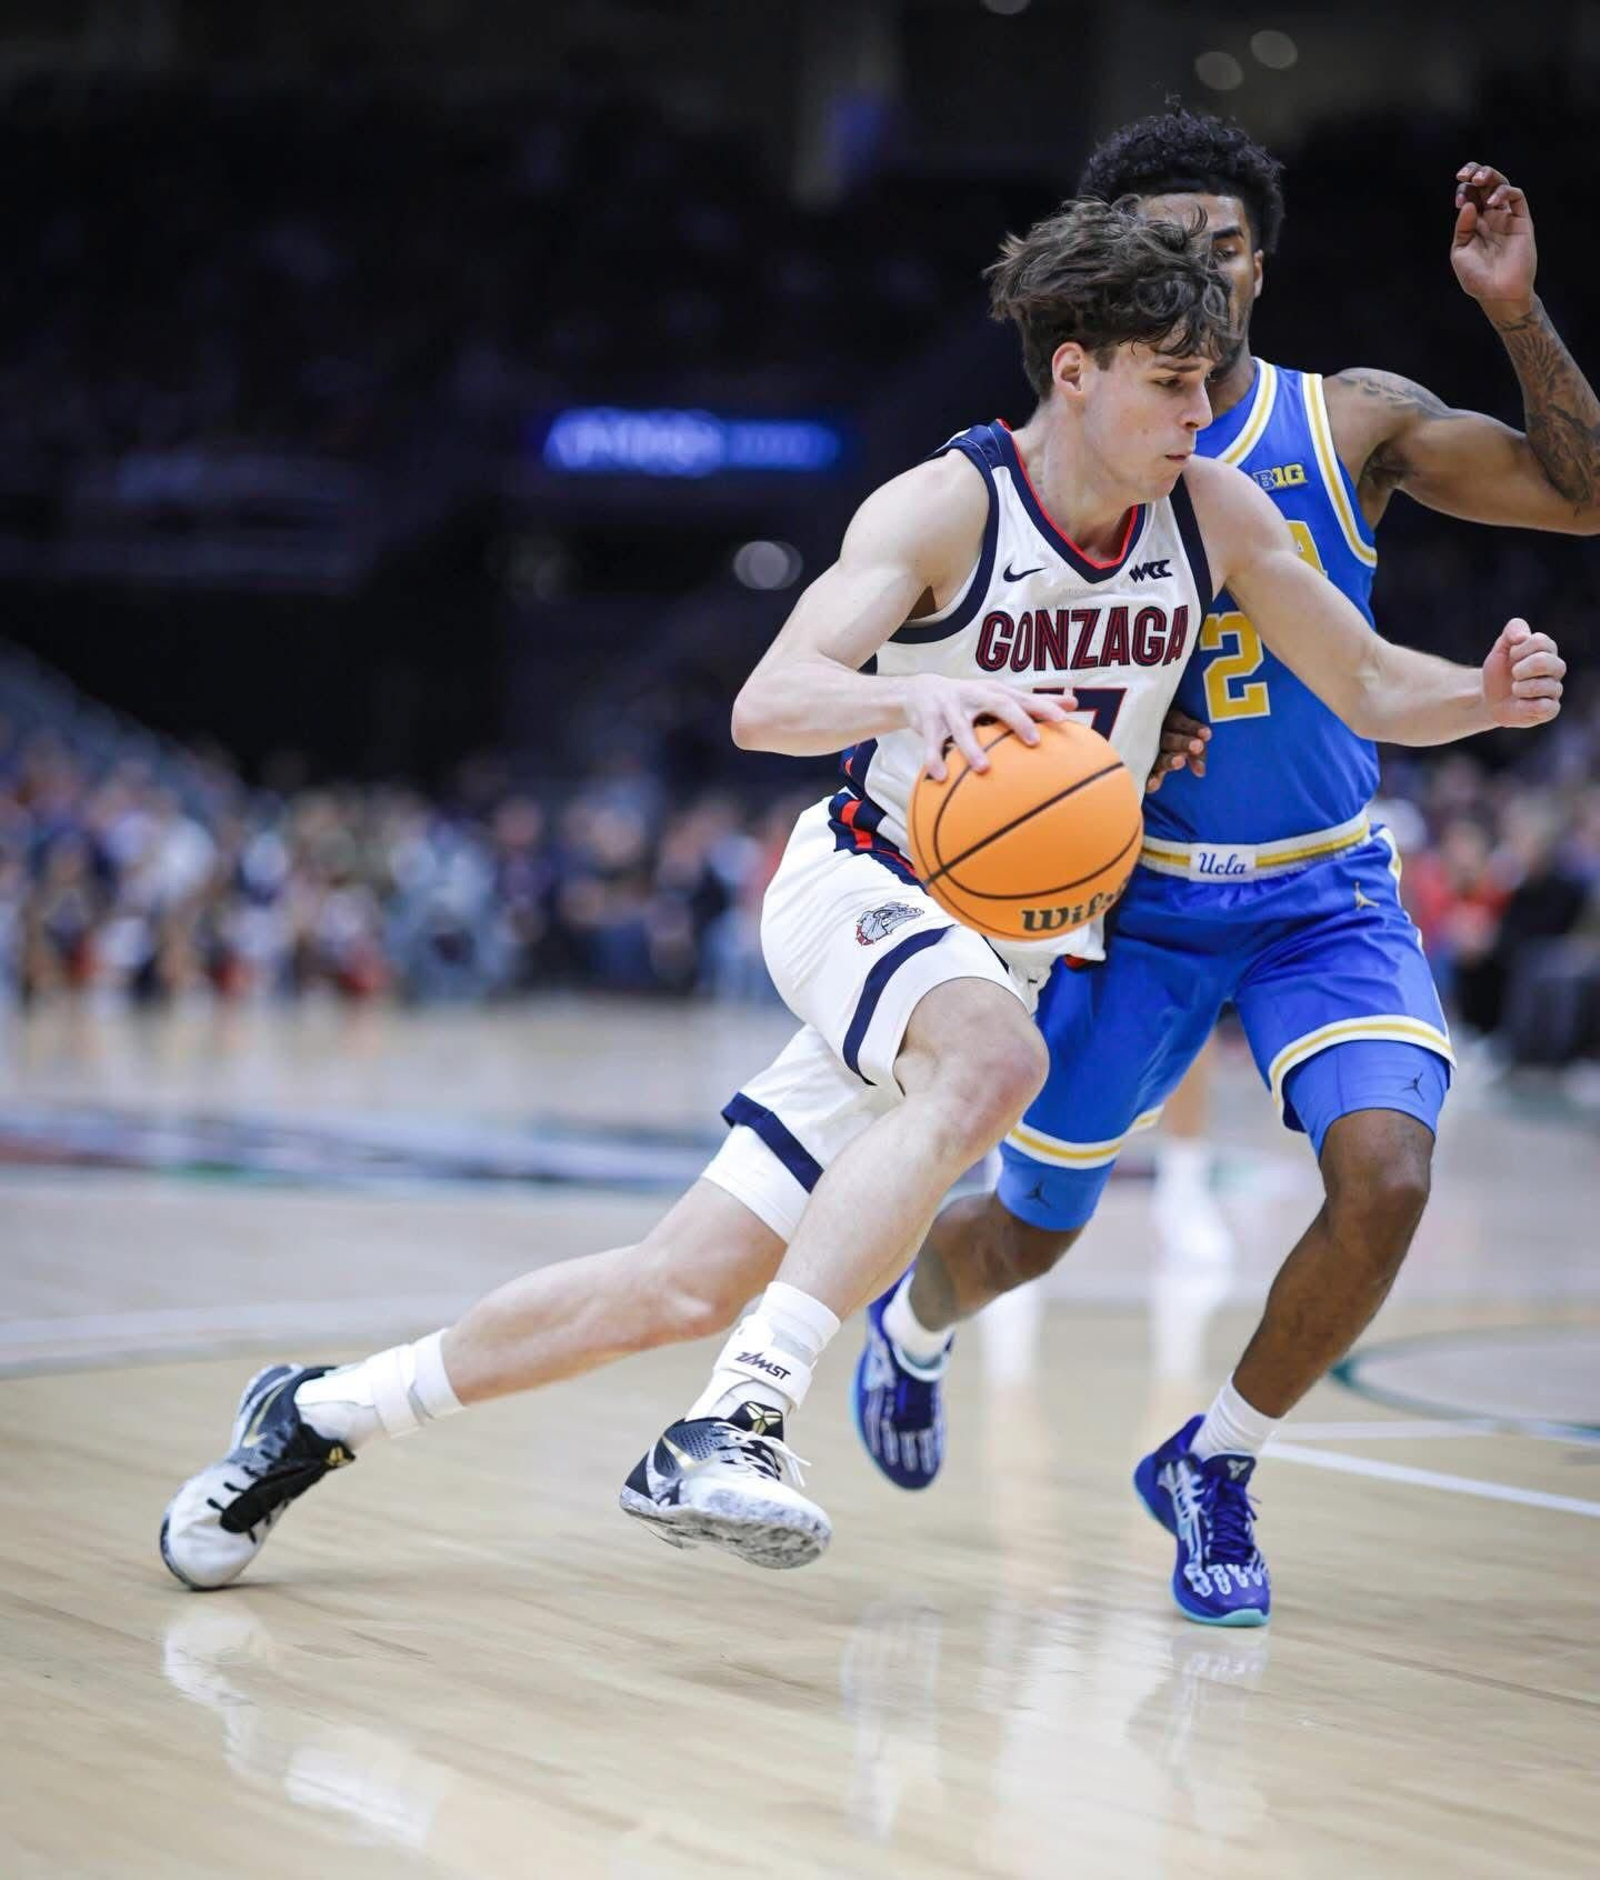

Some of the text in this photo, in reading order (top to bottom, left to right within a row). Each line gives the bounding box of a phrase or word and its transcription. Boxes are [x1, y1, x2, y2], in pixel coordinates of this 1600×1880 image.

[975, 605, 1189, 673] GONZAGA
[1200, 611, 1271, 723] 2
[1032, 686, 1128, 742] 7
[1199, 852, 1247, 876] Ucla
[1021, 892, 1120, 932] Wil
